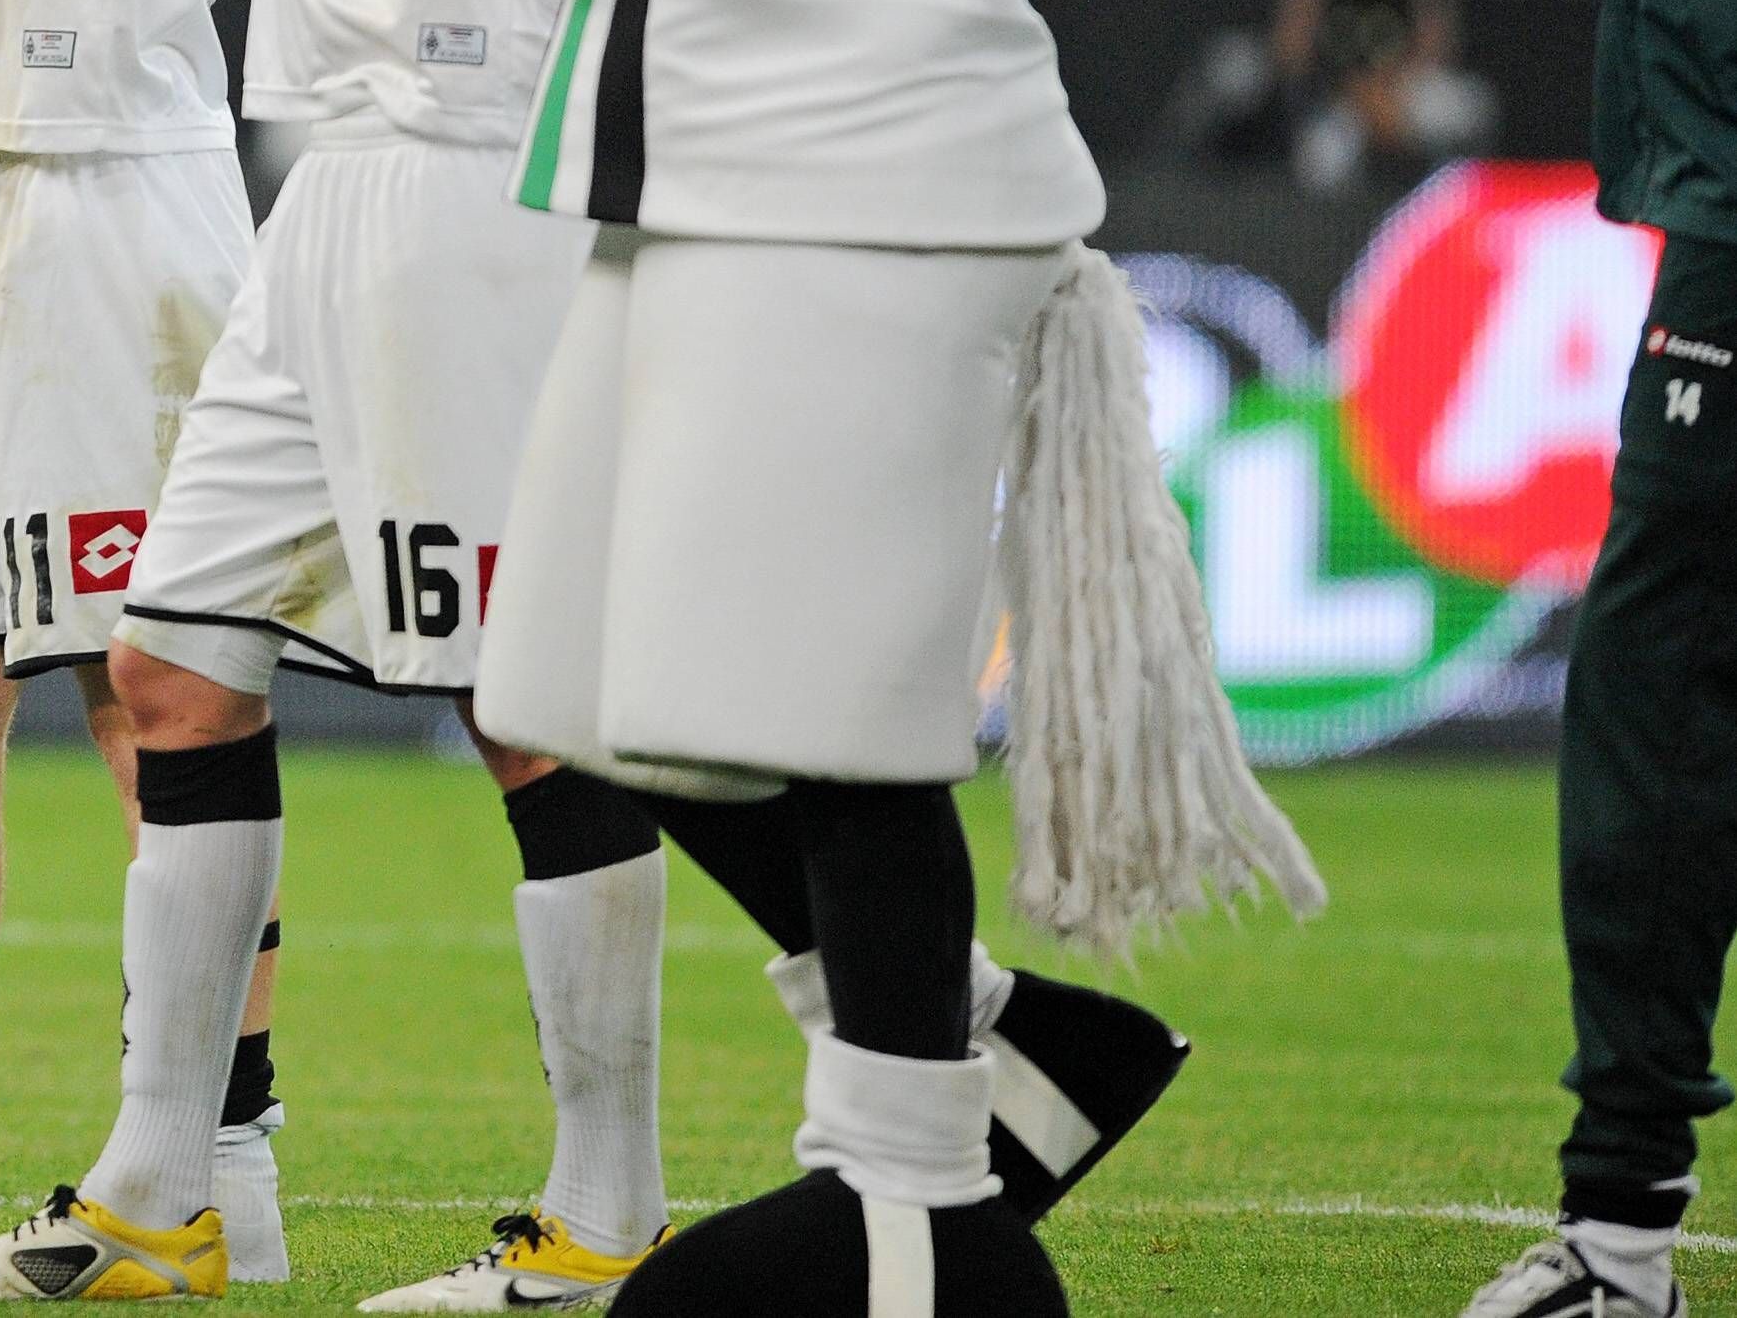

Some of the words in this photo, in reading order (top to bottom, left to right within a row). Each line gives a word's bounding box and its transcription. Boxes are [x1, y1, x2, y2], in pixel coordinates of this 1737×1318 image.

[1665, 377, 1702, 427] 14
[4, 513, 54, 629] 11
[379, 520, 460, 638] 16
